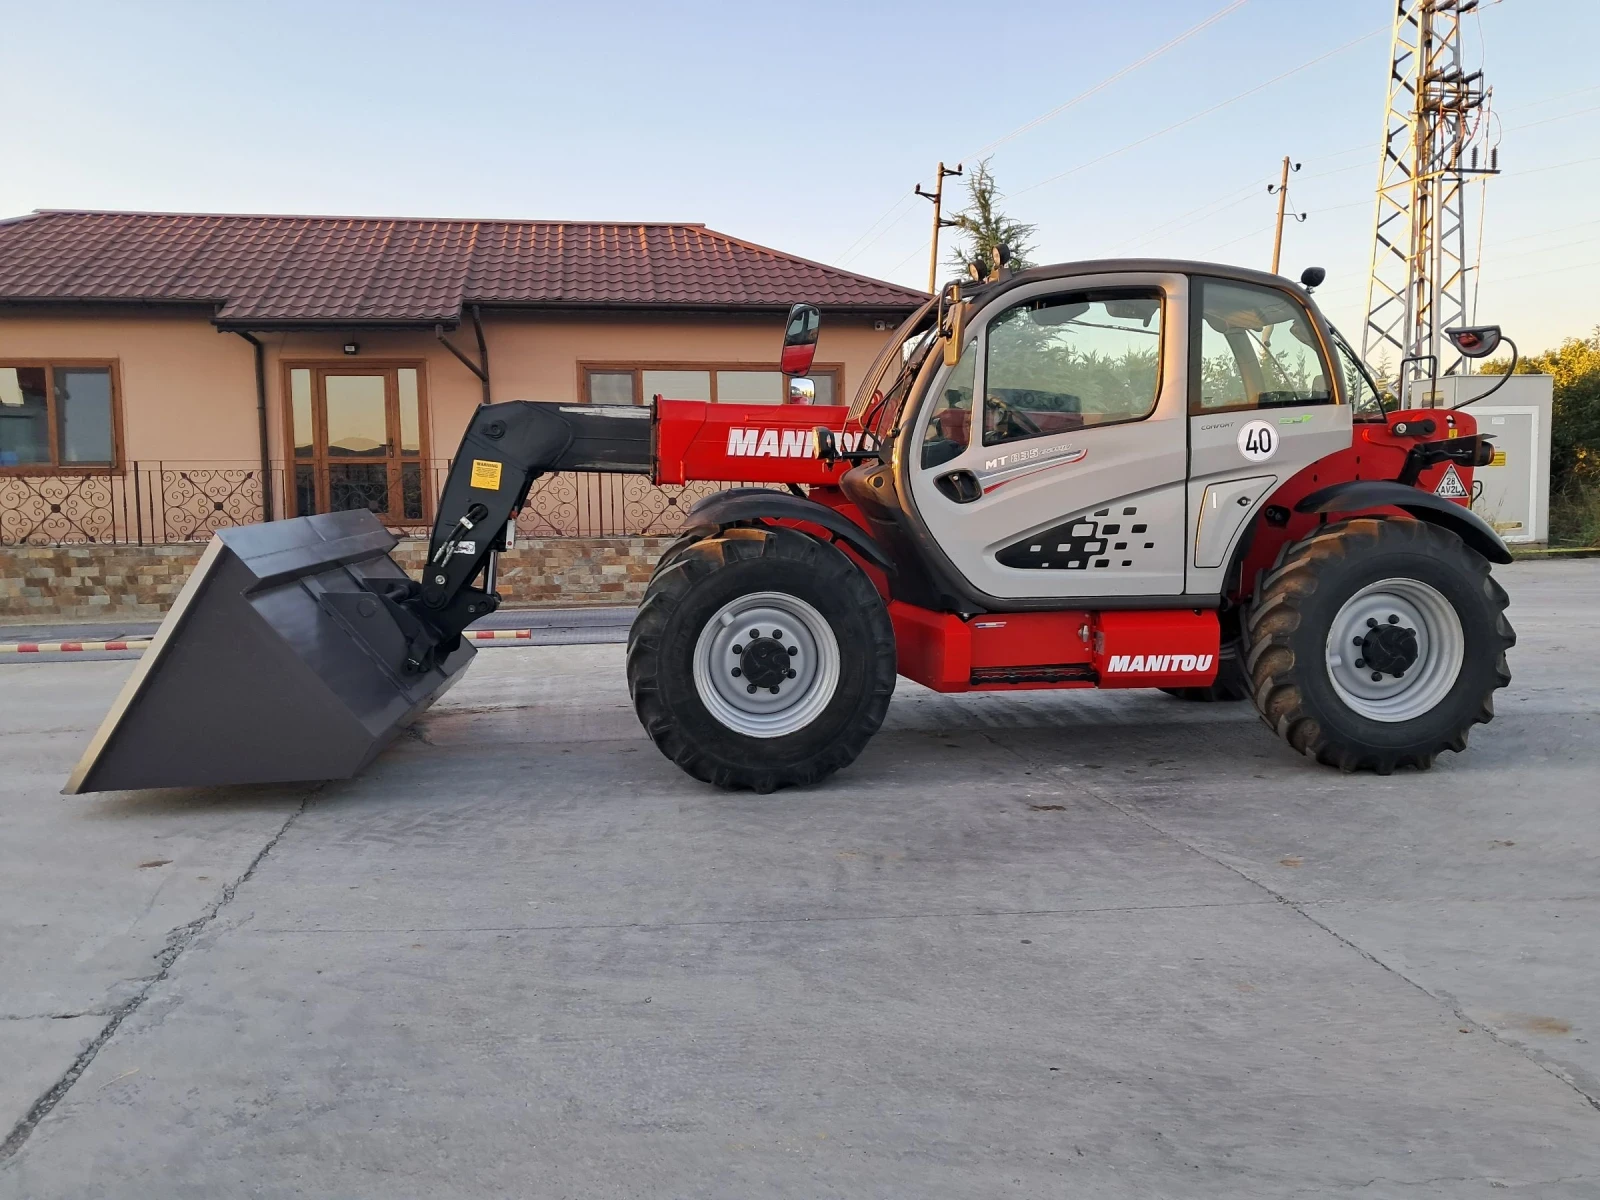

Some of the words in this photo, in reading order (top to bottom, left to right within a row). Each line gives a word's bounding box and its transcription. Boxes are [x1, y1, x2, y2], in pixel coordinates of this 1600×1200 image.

[1245, 427, 1272, 454] 40
[985, 456, 1008, 470] MT
[1010, 448, 1039, 463] 835
[1446, 477, 1456, 485] 28
[1107, 654, 1213, 672] MANITOU
